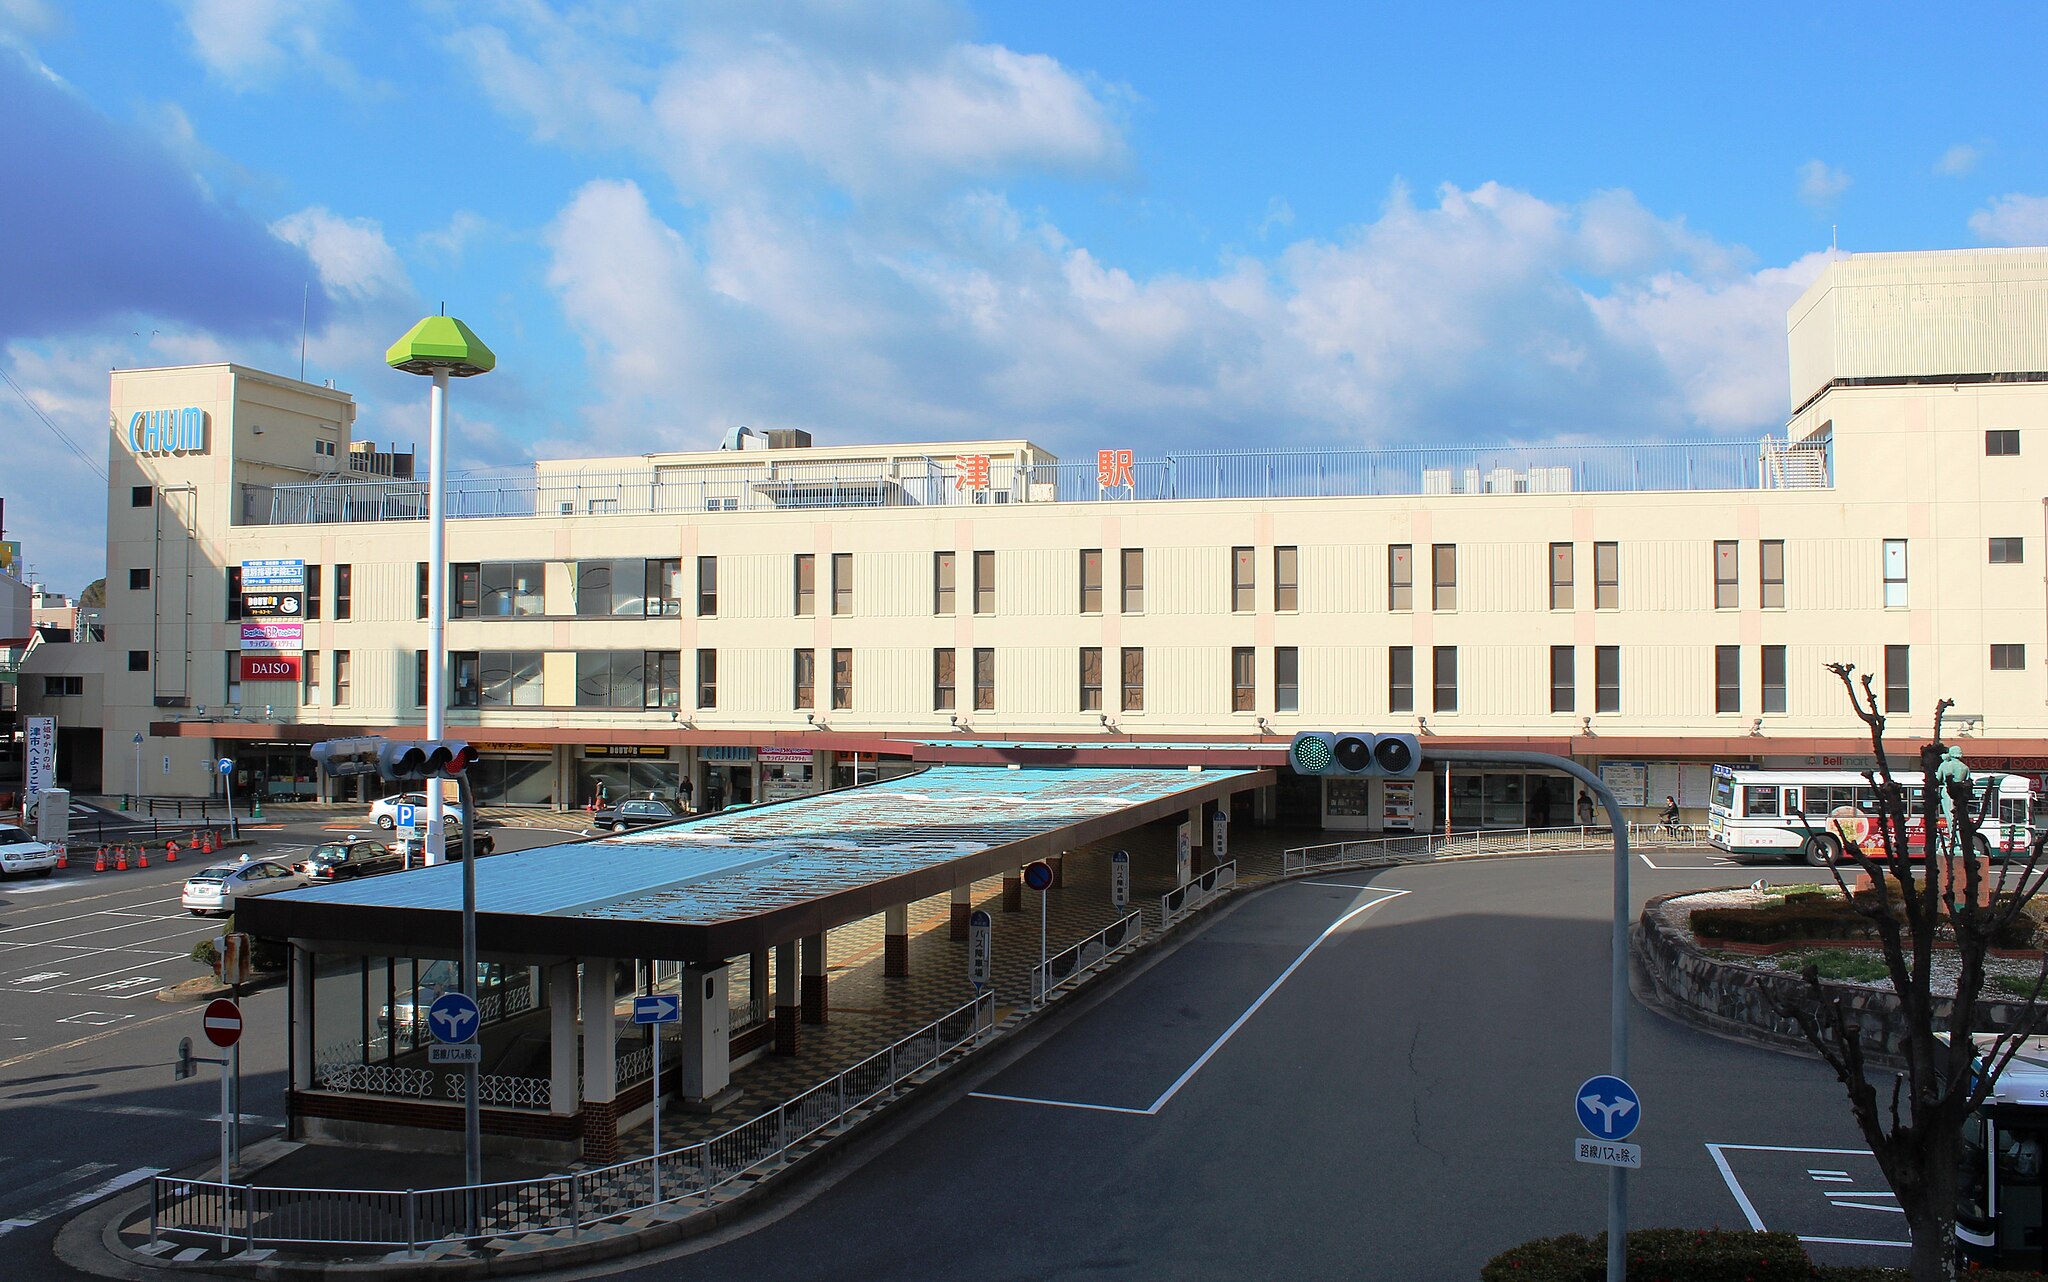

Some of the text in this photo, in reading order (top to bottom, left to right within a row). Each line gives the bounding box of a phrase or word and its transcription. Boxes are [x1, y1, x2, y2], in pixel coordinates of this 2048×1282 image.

[128, 406, 204, 453] CHUM
[955, 449, 1135, 491] 津 駅
[248, 595, 278, 606] DOUTOR
[252, 663, 290, 674] DAISO
[30, 727, 41, 795] 津市へようこそ
[1823, 756, 1869, 766] Bellmart
[1962, 757, 2008, 769] ister
[400, 806, 412, 825] P
[1580, 1143, 1636, 1164] 路線バスを除く
